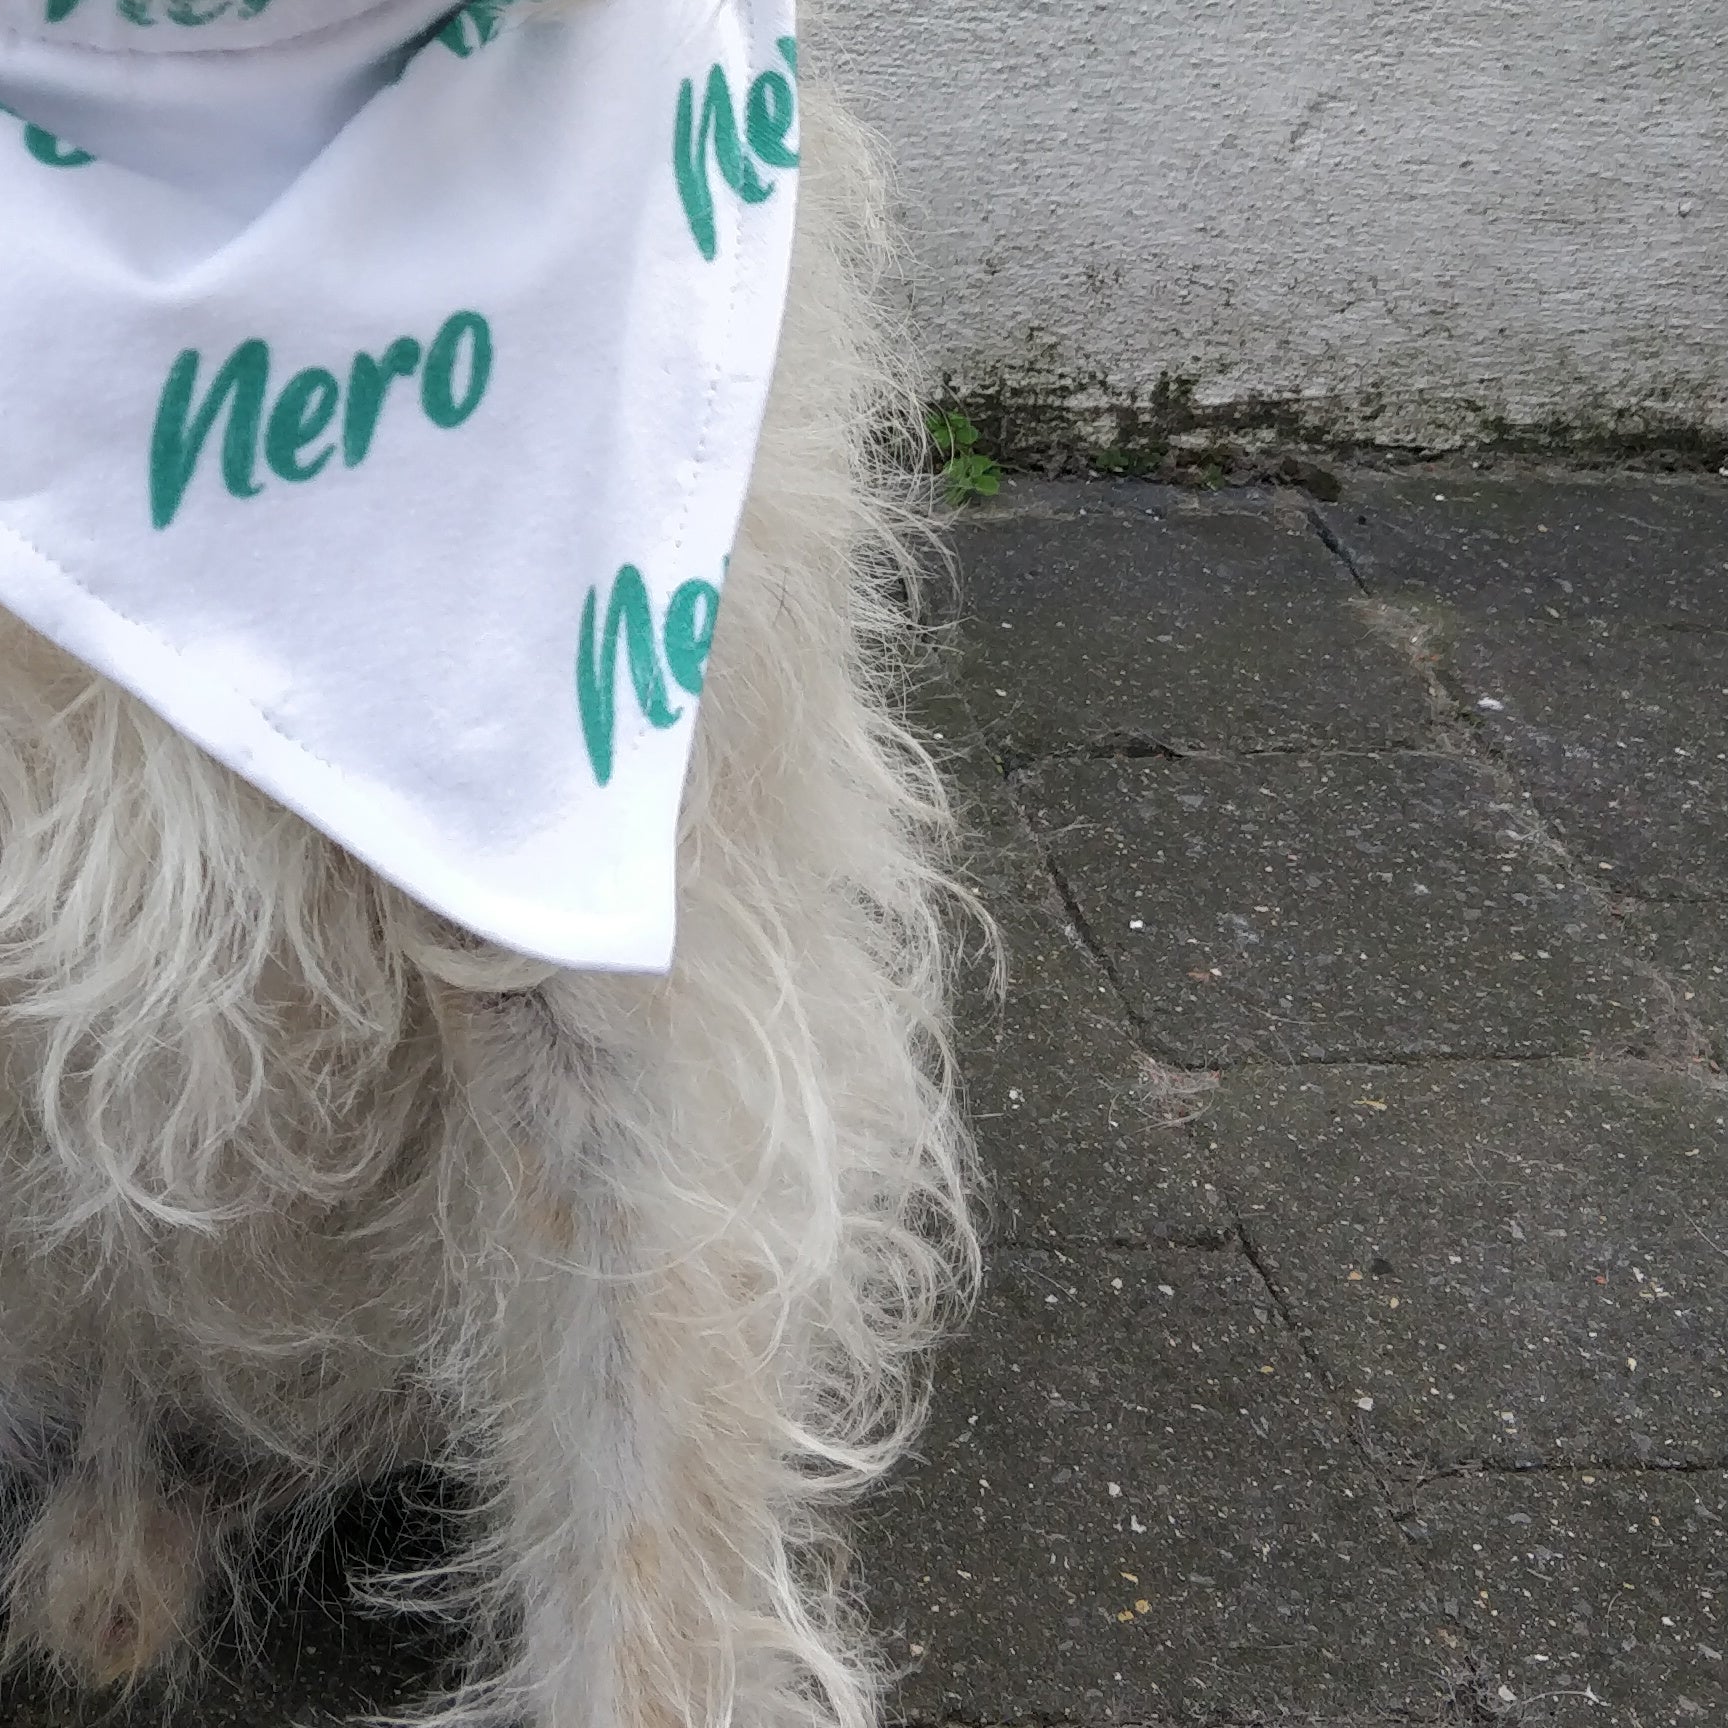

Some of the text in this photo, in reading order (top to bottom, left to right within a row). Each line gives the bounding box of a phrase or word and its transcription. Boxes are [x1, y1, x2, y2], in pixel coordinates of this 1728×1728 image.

[673, 35, 800, 261] Ne
[148, 309, 494, 530] Nero
[575, 555, 730, 788] Ne
